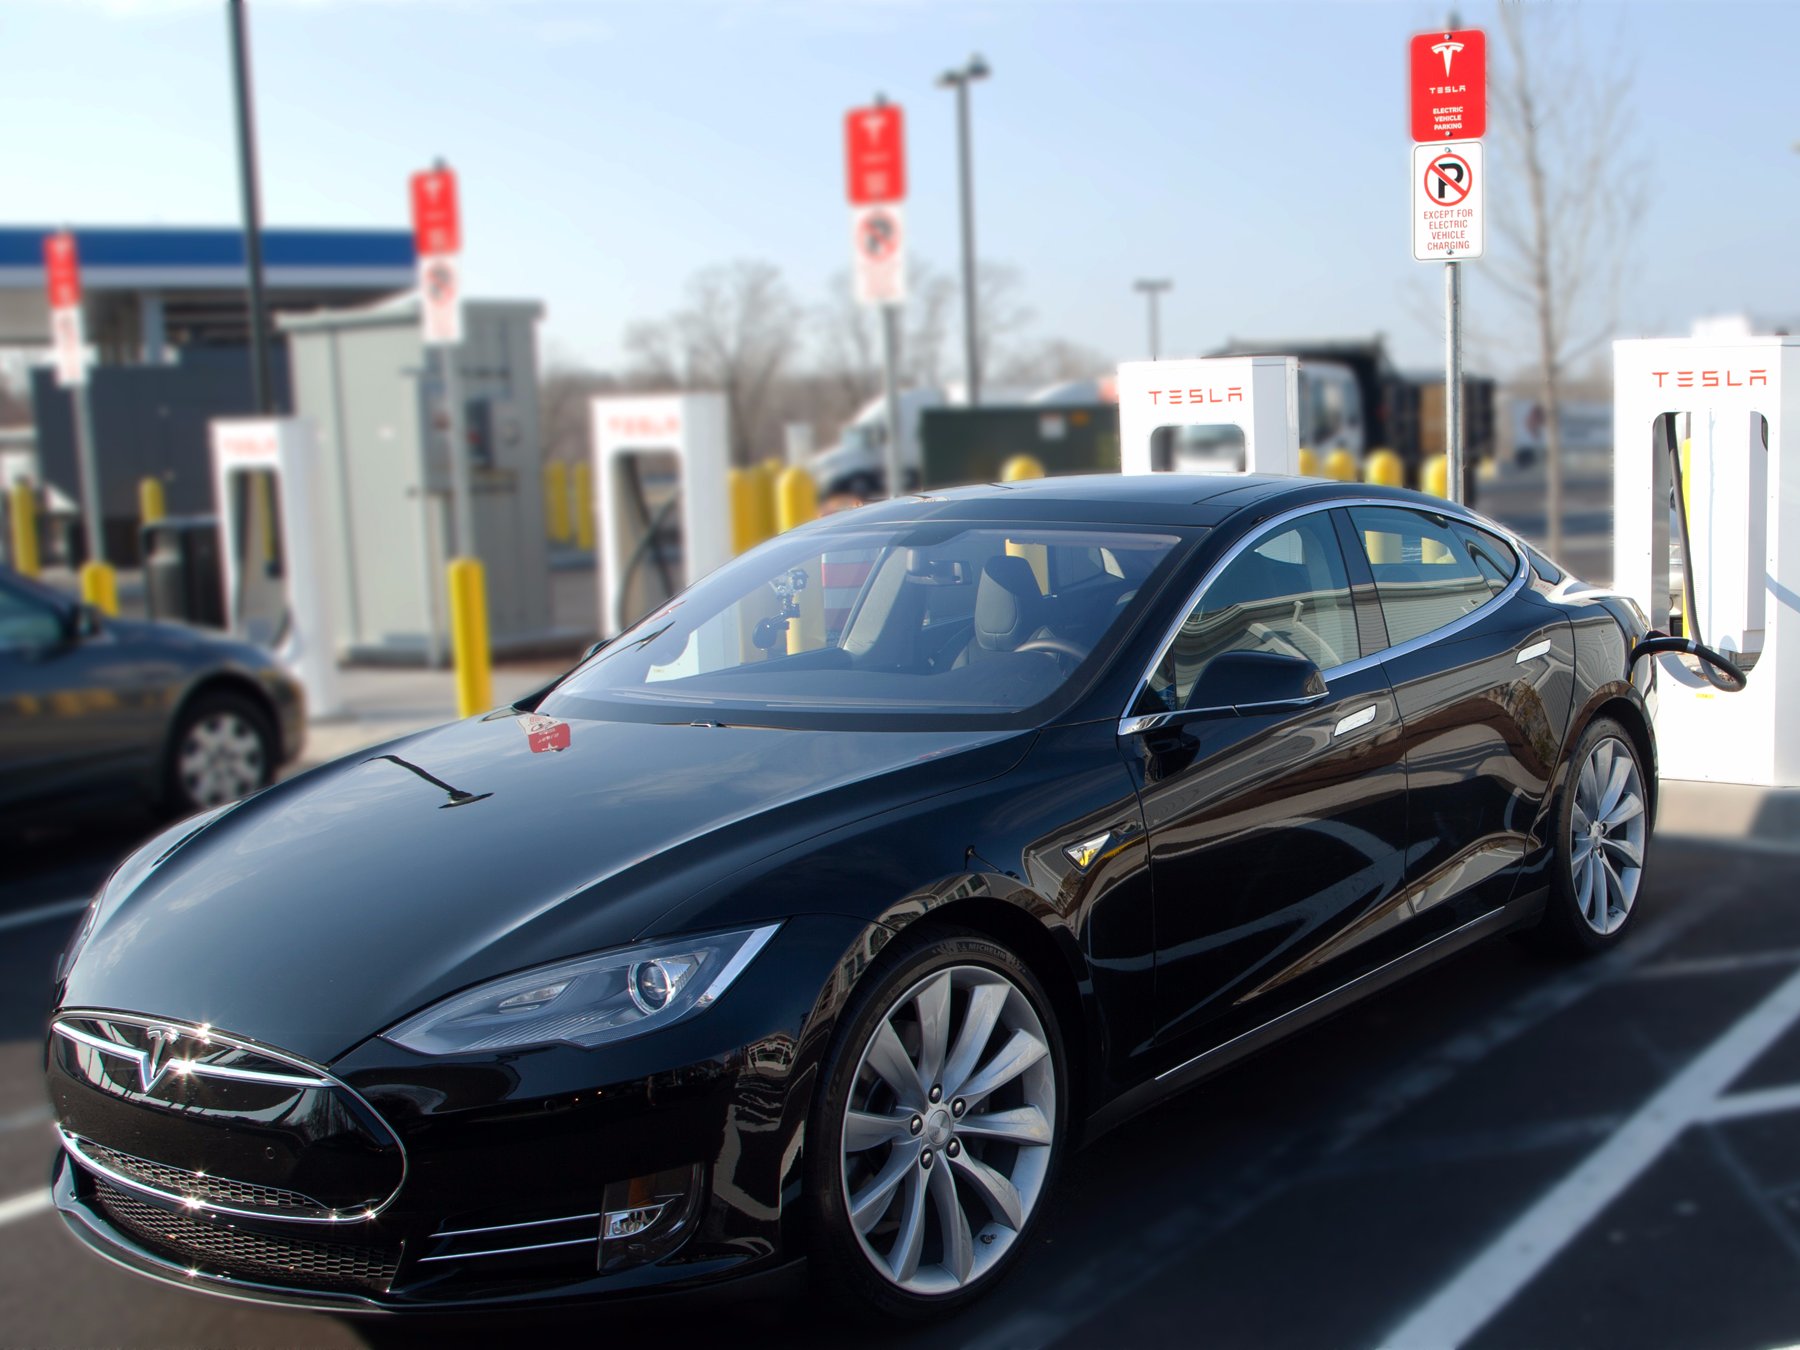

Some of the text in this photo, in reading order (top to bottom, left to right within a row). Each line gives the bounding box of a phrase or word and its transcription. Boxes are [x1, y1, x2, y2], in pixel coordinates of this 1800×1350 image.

[1429, 85, 1466, 94] TESLA
[1433, 106, 1463, 114] ELECTRIC
[1434, 114, 1462, 122] VEHICLE
[1434, 122, 1463, 130] PARKING
[1423, 208, 1474, 220] EXCEPT FOR
[1428, 219, 1468, 230] ELECTRIC
[1431, 230, 1466, 240] VEHICLE
[1427, 240, 1470, 251] CHARGING
[1651, 369, 1767, 388] TESLA
[1148, 387, 1242, 405] TESLA
[968, 943, 1007, 960] MICHELIN
